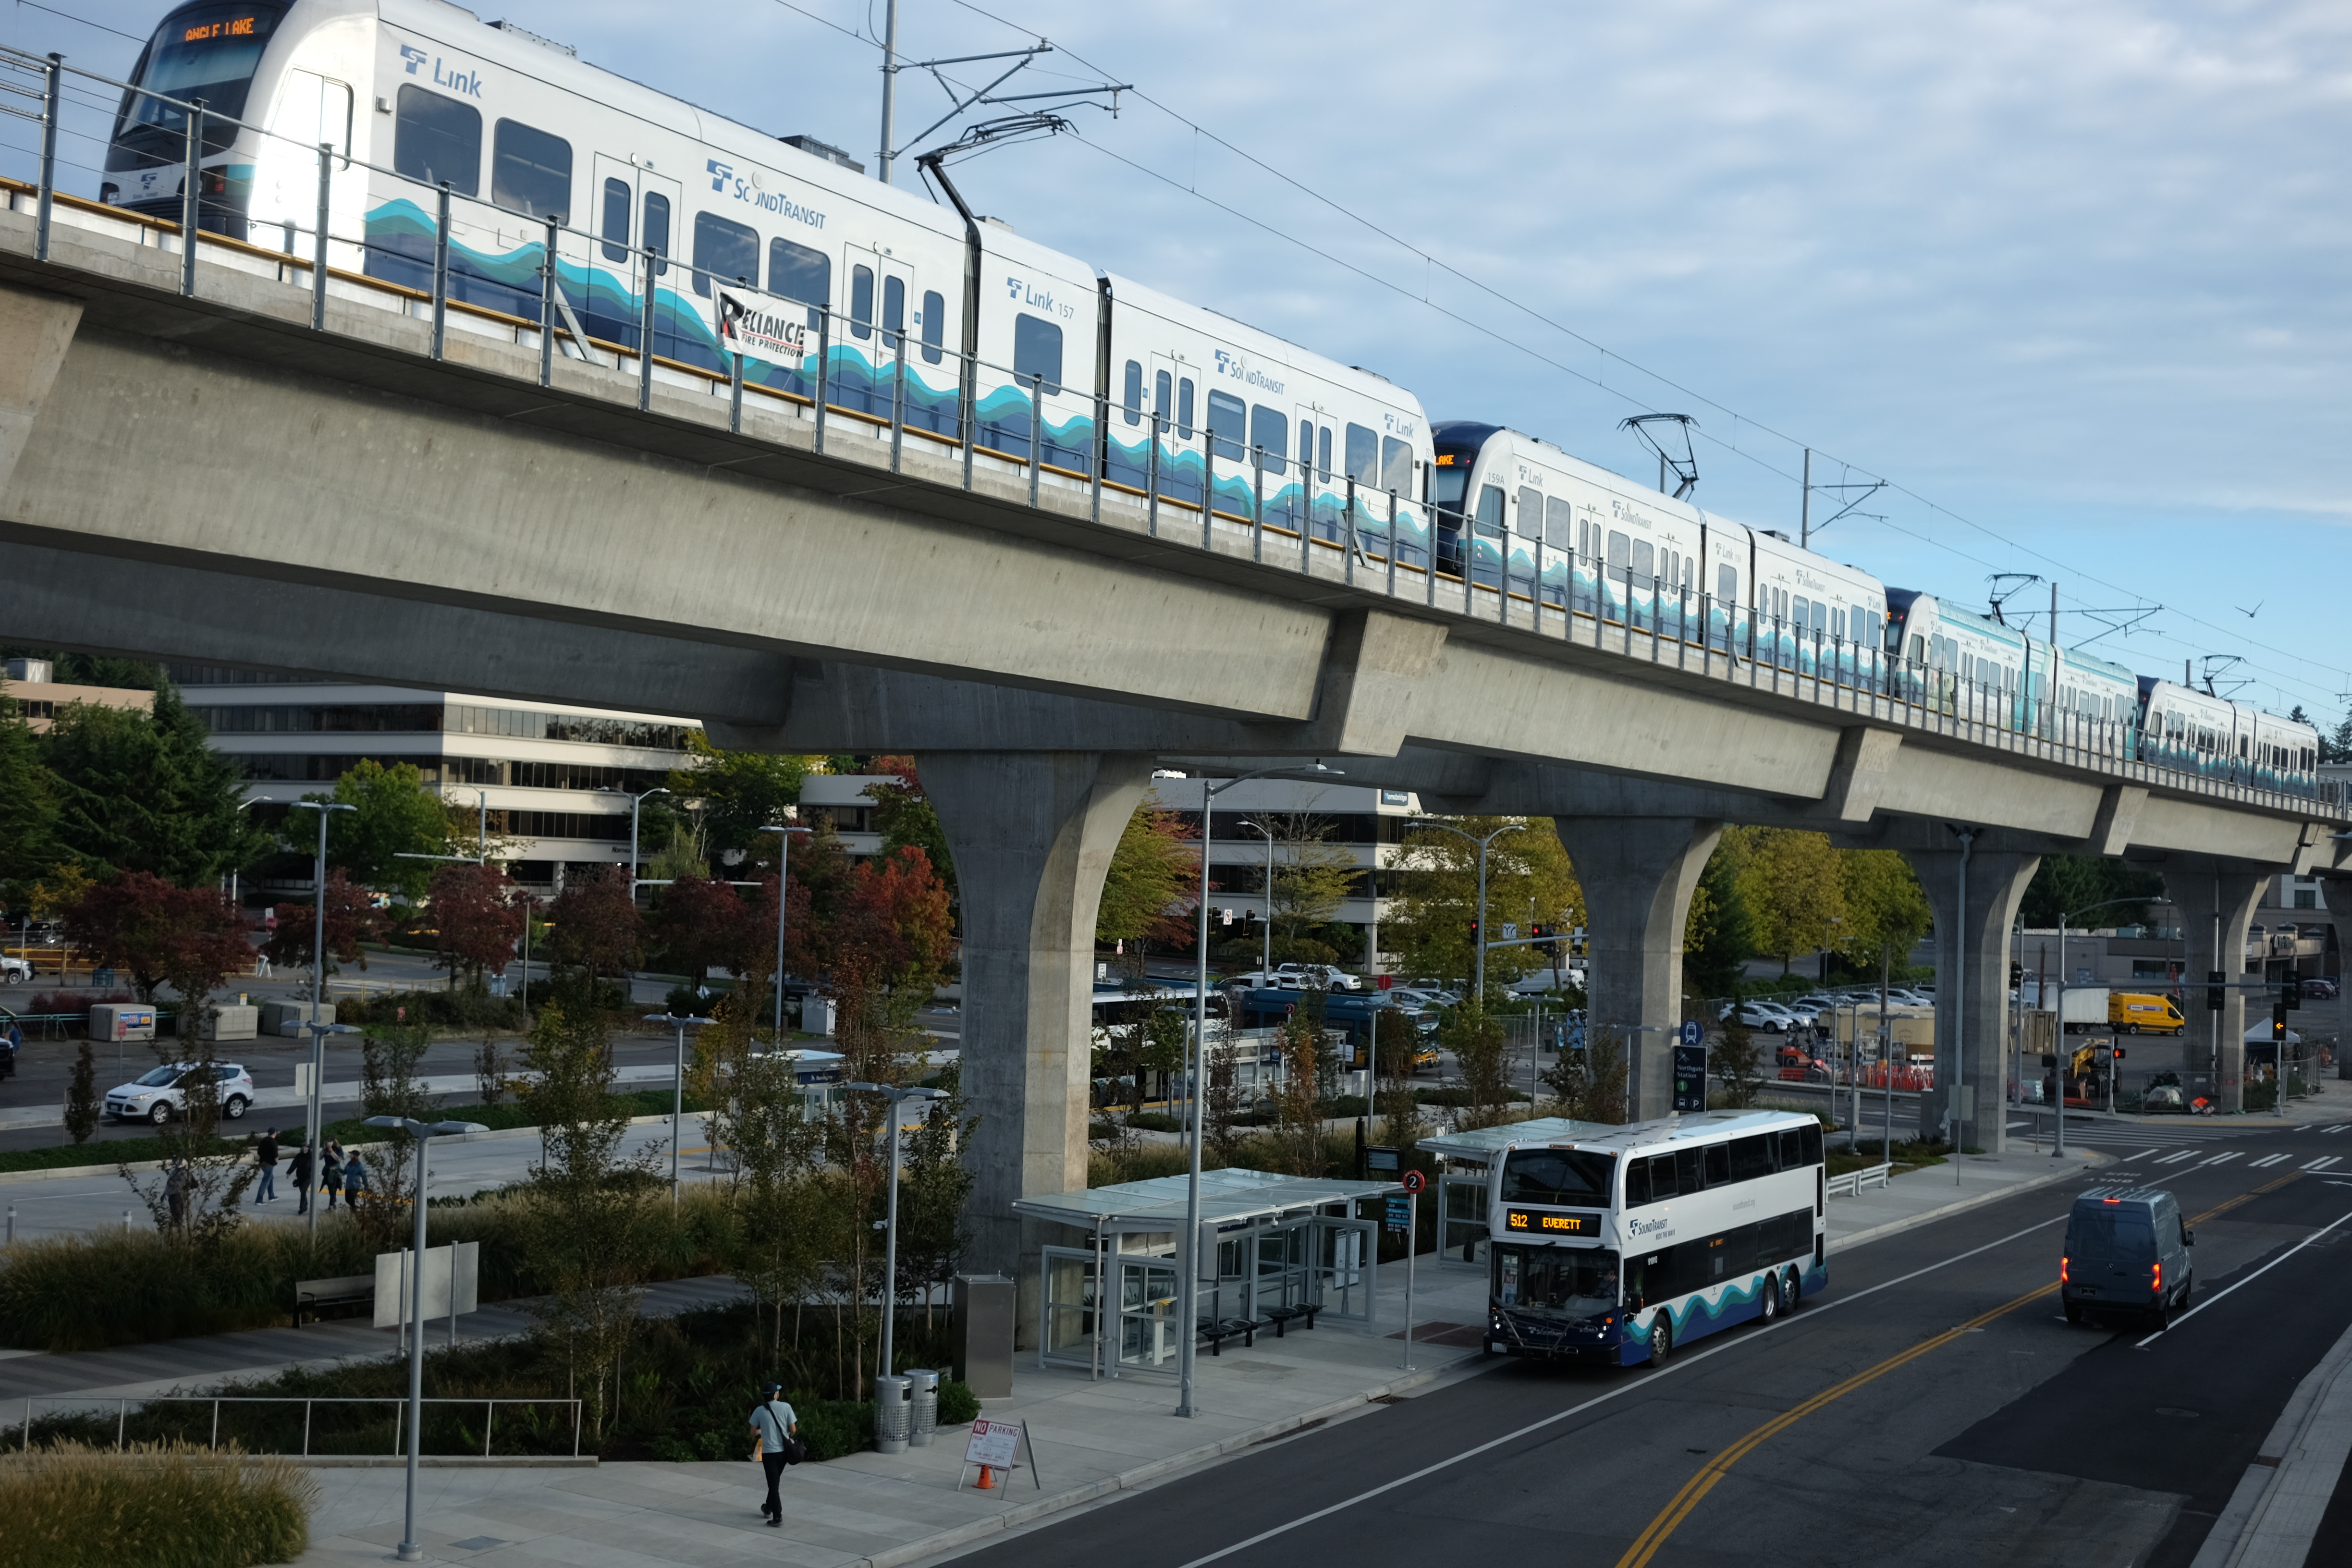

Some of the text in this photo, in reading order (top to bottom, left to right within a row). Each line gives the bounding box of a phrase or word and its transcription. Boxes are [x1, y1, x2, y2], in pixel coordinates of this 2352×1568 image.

[434, 57, 482, 98] Link
[1026, 284, 1074, 319] Link 157
[720, 292, 805, 346] RELIANCE
[759, 338, 804, 357] PROTECTION
[1396, 417, 1413, 438] Link
[1488, 472, 1505, 485] 159A
[1529, 468, 1543, 487] Link
[1677, 1065, 1704, 1073] Northgate
[1409, 1176, 1417, 1188] 2
[1511, 1213, 1581, 1230] 512 EVERETT
[975, 1421, 1018, 1437] NO PARKING
